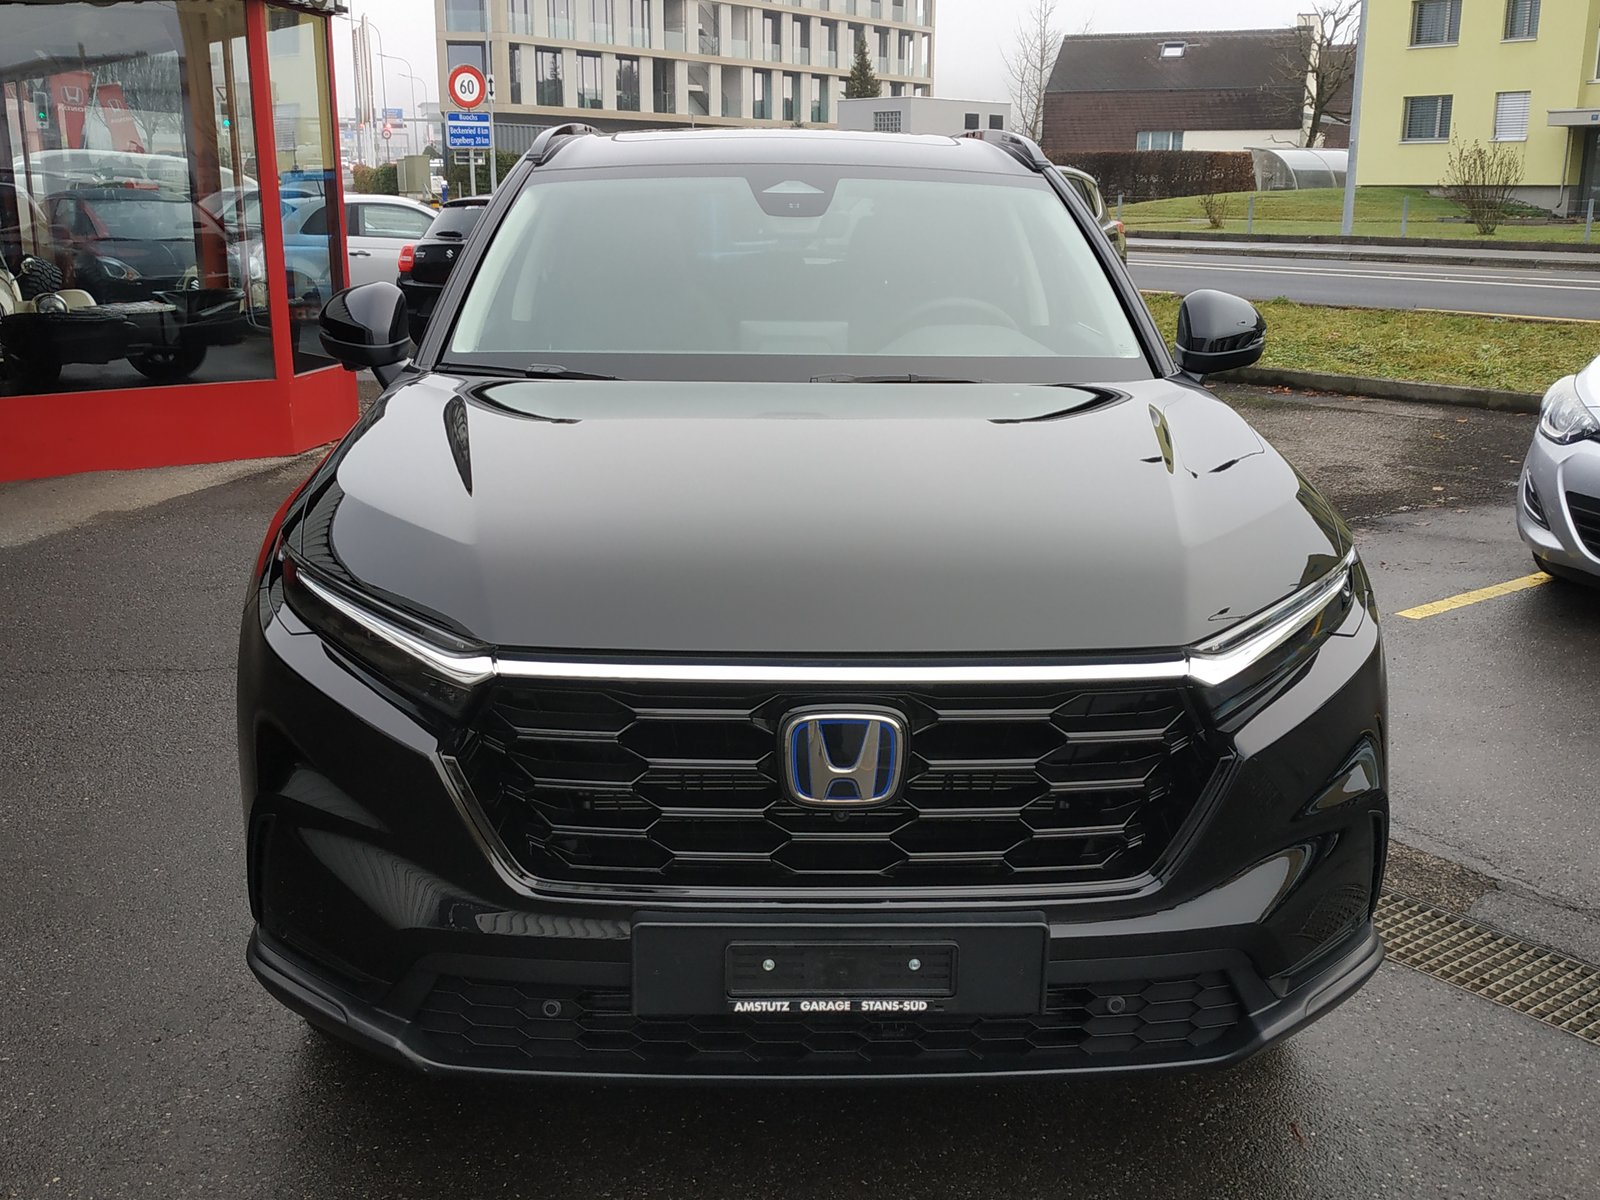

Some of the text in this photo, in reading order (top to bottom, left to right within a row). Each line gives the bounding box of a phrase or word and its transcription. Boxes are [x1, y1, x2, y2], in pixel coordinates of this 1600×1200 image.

[460, 79, 475, 95] 60
[482, 127, 489, 135] km
[450, 136, 475, 145] Engelberg
[481, 136, 489, 144] km
[734, 1000, 928, 1012] AMSTUTZ GARAGE STANS-SÜD
